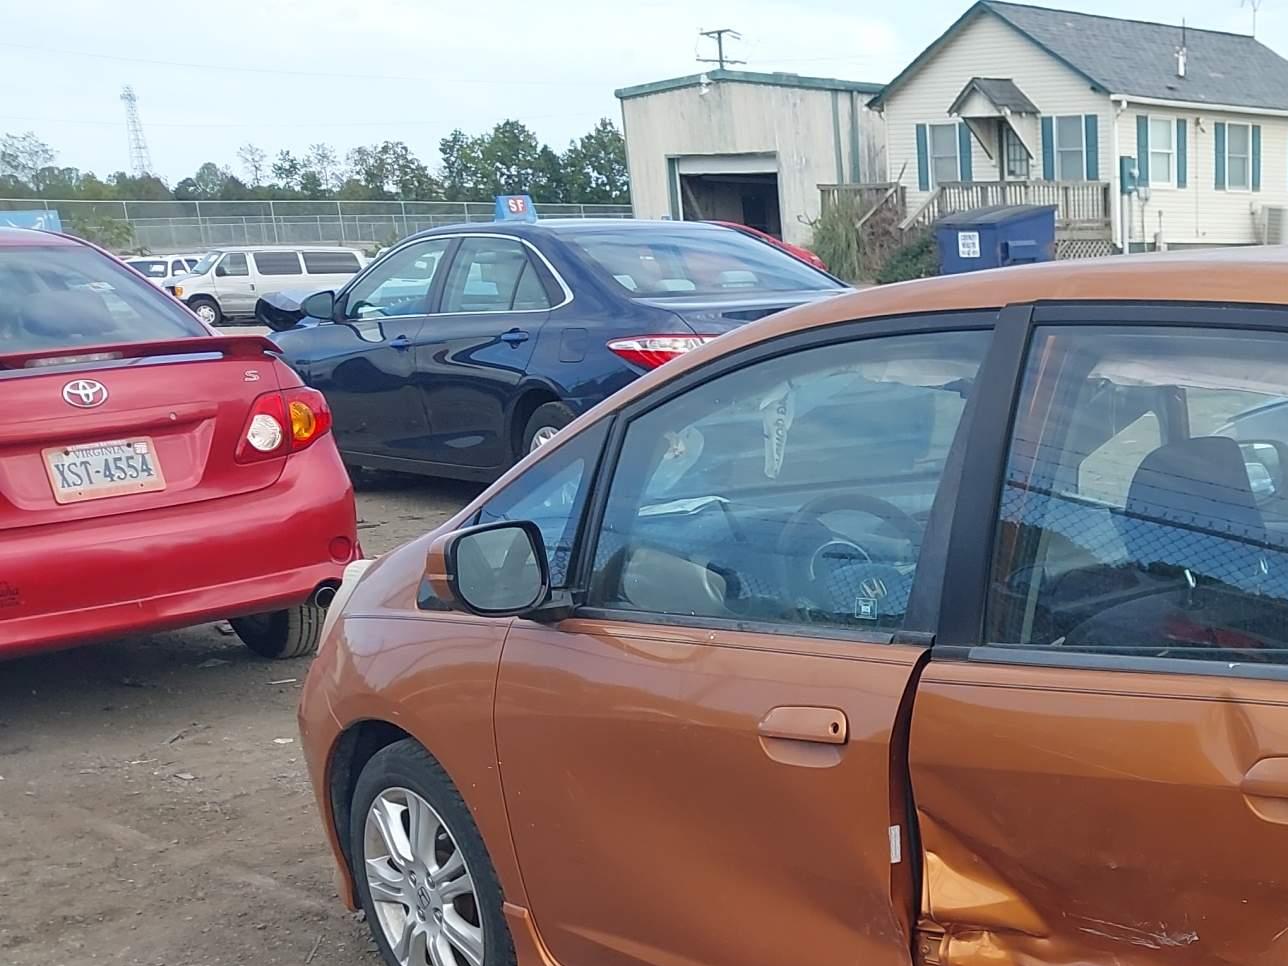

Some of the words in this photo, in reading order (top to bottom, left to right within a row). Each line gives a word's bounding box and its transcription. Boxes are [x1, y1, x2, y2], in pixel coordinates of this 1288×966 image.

[508, 199, 525, 212] SF
[244, 370, 260, 382] S
[73, 446, 125, 459] VIRGINIA
[54, 454, 154, 489] XST-4554
